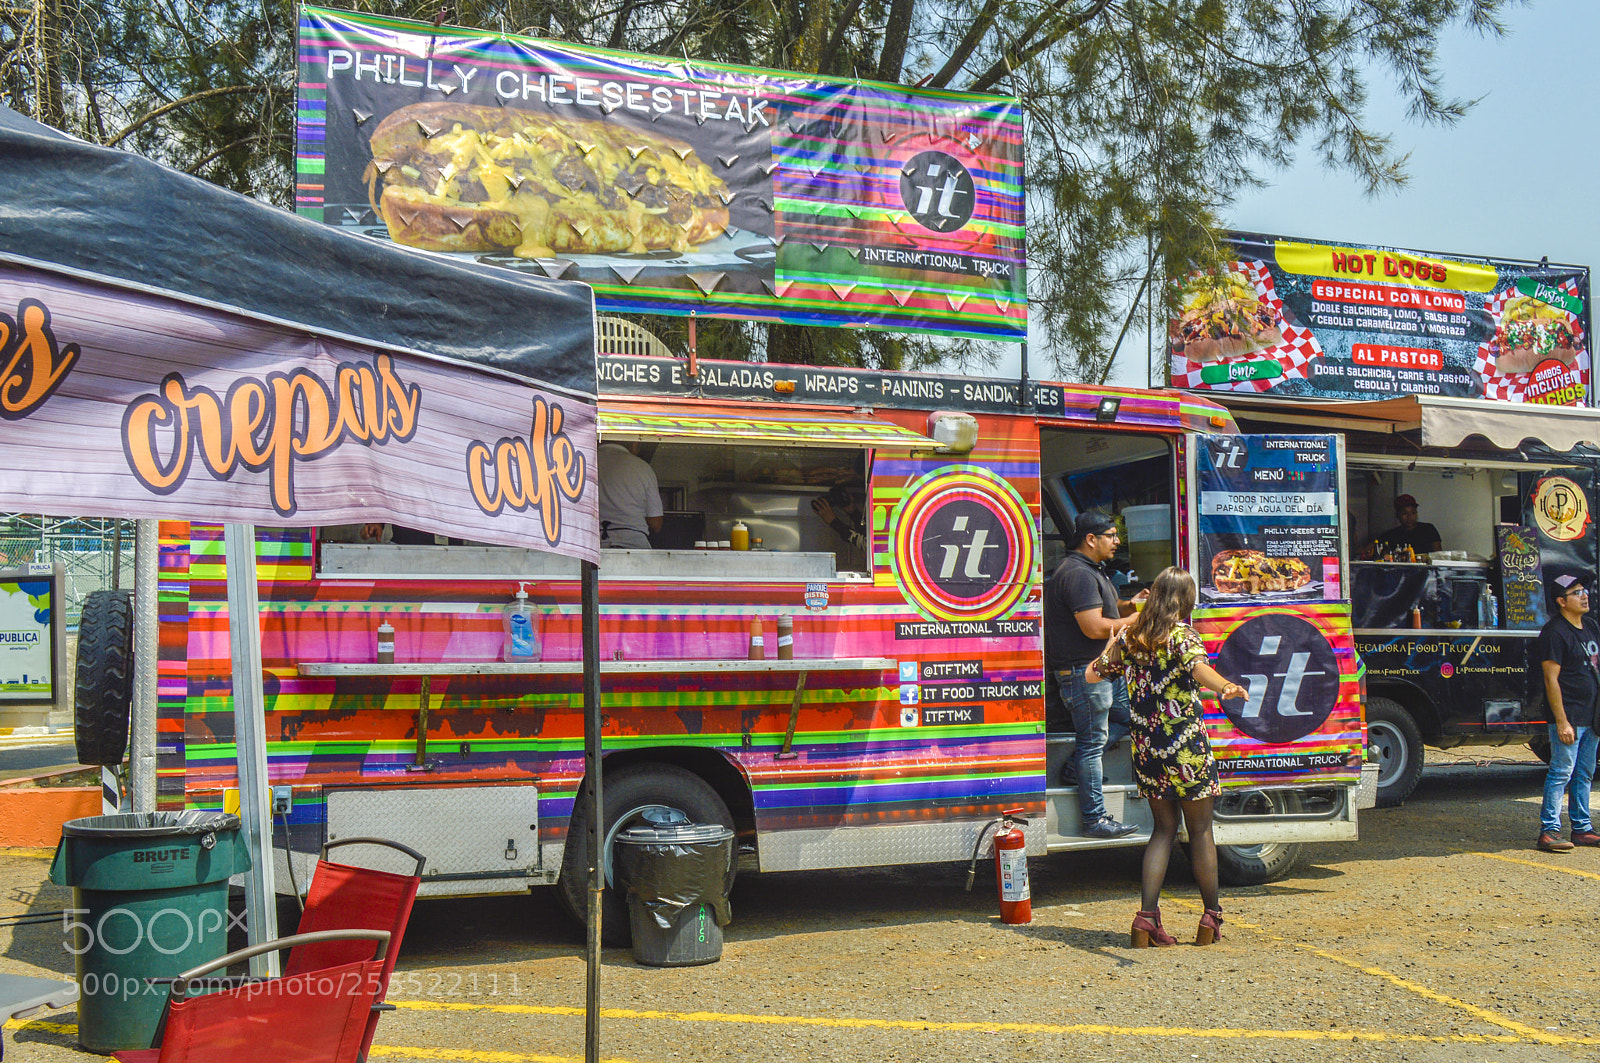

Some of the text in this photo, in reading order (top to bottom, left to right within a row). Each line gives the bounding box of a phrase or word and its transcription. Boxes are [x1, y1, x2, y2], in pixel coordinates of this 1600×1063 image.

[326, 49, 769, 127] PHILLY CHEESESTEAK
[916, 163, 968, 218] it
[864, 247, 1010, 275] INTERNATIONAL TRUCK
[1332, 252, 1447, 282] HOT DOGS
[1316, 285, 1463, 309] ESPECIAL CON LOMO
[1534, 282, 1568, 309] Pastor
[1311, 301, 1341, 313] DOBLE
[1394, 309, 1422, 322] LOMO,
[1357, 348, 1439, 366] AL PASTOR
[1314, 364, 1345, 376] DOBLE
[804, 374, 859, 394] WRAPS
[881, 379, 944, 399] PANINIS
[963, 383, 1059, 406] SANDWHES
[121, 352, 421, 518] crepas
[1265, 440, 1327, 449] INTERNATIONAL
[1215, 440, 1245, 469] it
[1297, 453, 1326, 462] TRUCK
[466, 395, 586, 547] café
[1254, 469, 1284, 480] MENÚ
[1216, 502, 1323, 512] PAPAS Y AGUA DEL DÍA
[1228, 495, 1306, 503] TODOS INCLUYEN
[938, 515, 999, 579] it
[900, 621, 1034, 635] INTERNATIONAL TRUCK
[923, 663, 979, 677] @ITFTMX
[1240, 635, 1325, 718] it
[923, 685, 1040, 699] IT FOOD TRUCK MX
[925, 710, 972, 722] ITFTMX
[1218, 755, 1343, 770] INTERNATIONAL TRUCK
[133, 848, 190, 862] BRUTE
